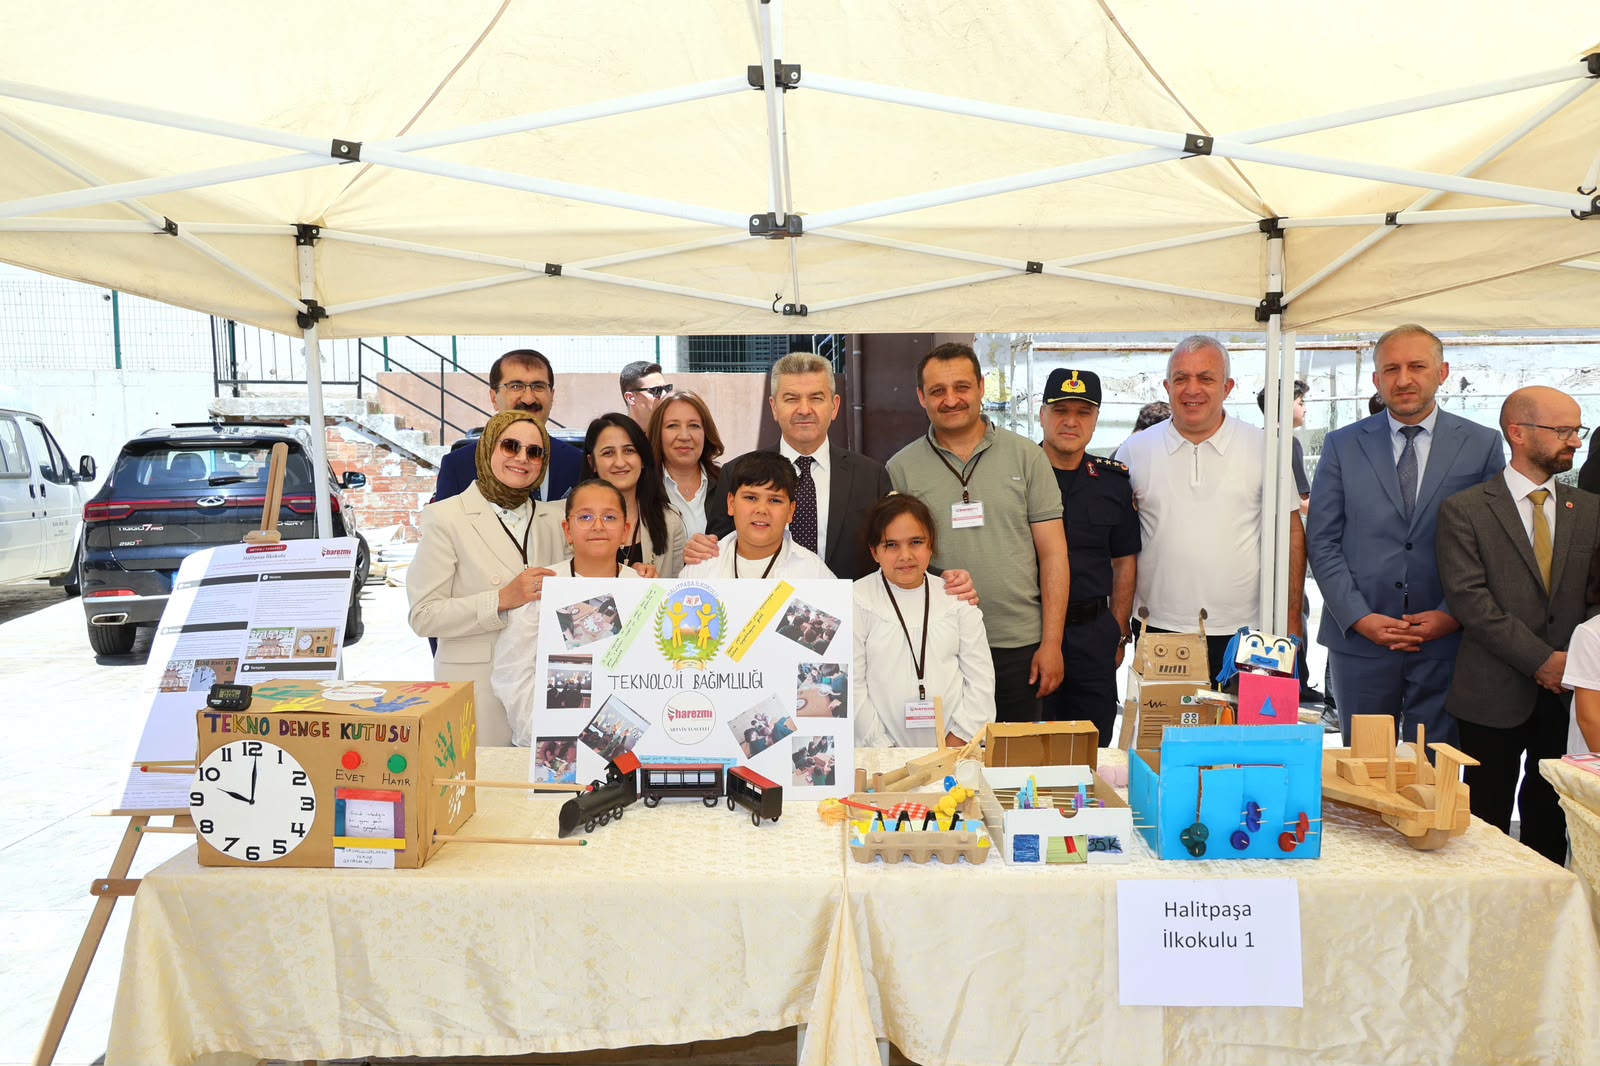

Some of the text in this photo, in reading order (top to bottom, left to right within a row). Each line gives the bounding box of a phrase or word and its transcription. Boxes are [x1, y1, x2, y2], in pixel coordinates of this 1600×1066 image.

[607, 669, 764, 690] TEKNOLOJİ BAĞIMLILIĞI
[675, 708, 713, 719] harezmi
[204, 713, 410, 743] TEKNO DENGE KUTUSU
[221, 748, 232, 762] 11
[242, 742, 262, 756] 12
[277, 750, 283, 764] 1
[199, 767, 220, 781] 10
[292, 771, 307, 785] 2
[335, 768, 366, 783] EVET
[382, 772, 411, 787] HAYIR
[190, 792, 204, 806] 9
[300, 797, 314, 811] 3
[200, 819, 214, 834] 8
[291, 822, 306, 837] 4
[222, 837, 240, 852] 7
[273, 839, 287, 854] 5
[245, 846, 260, 861] 6
[1165, 900, 1252, 921] Halitpaşa
[1163, 928, 1255, 948] İlkokulu 1
